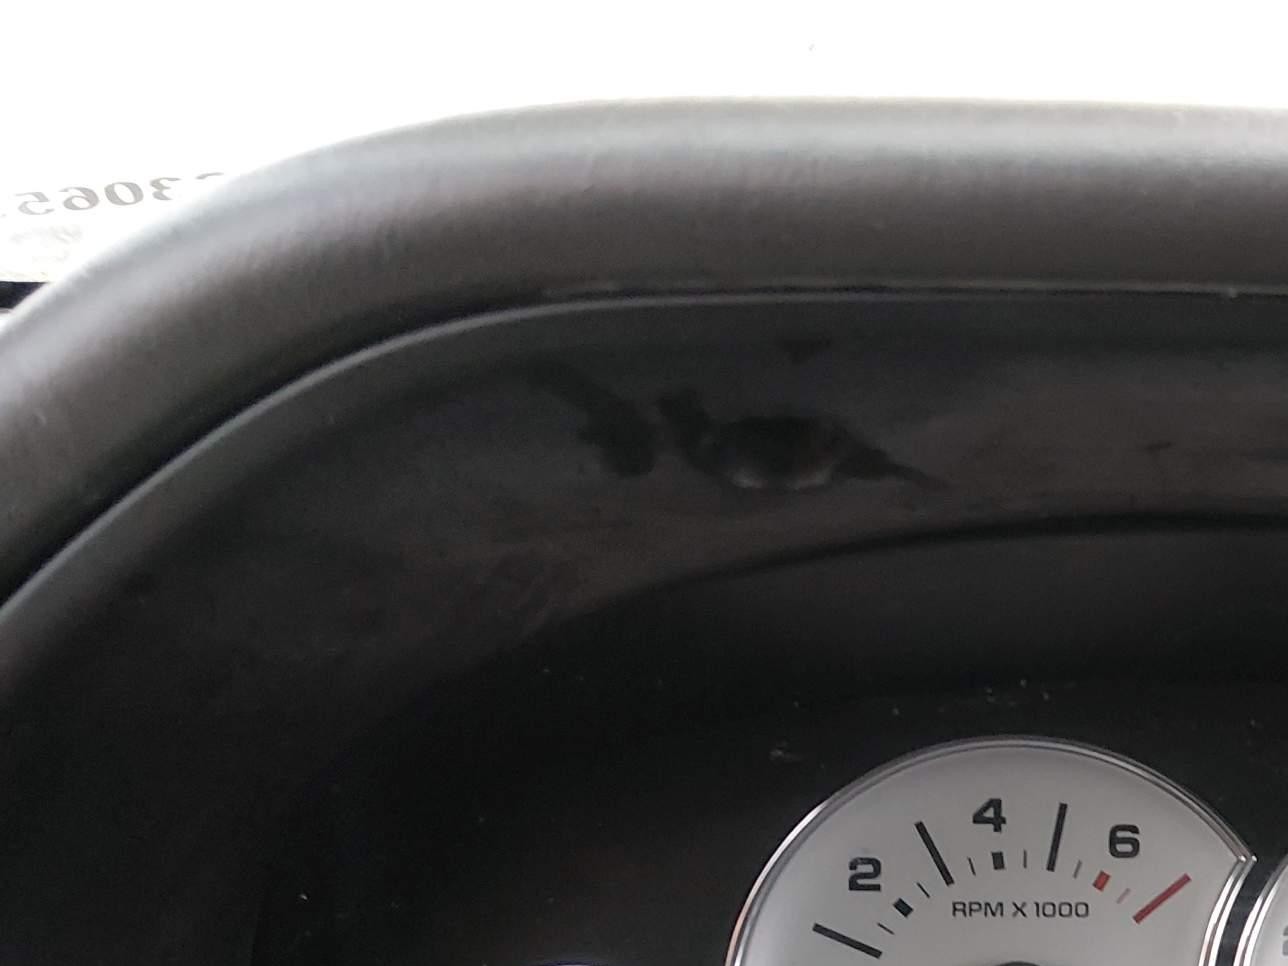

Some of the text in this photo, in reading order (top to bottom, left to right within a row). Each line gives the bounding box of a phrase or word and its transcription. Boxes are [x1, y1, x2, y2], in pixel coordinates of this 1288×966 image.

[973, 799, 1006, 832] 4
[1109, 824, 1140, 858] 6
[849, 857, 881, 891] 2
[952, 902, 1089, 917] RPM X 1000
